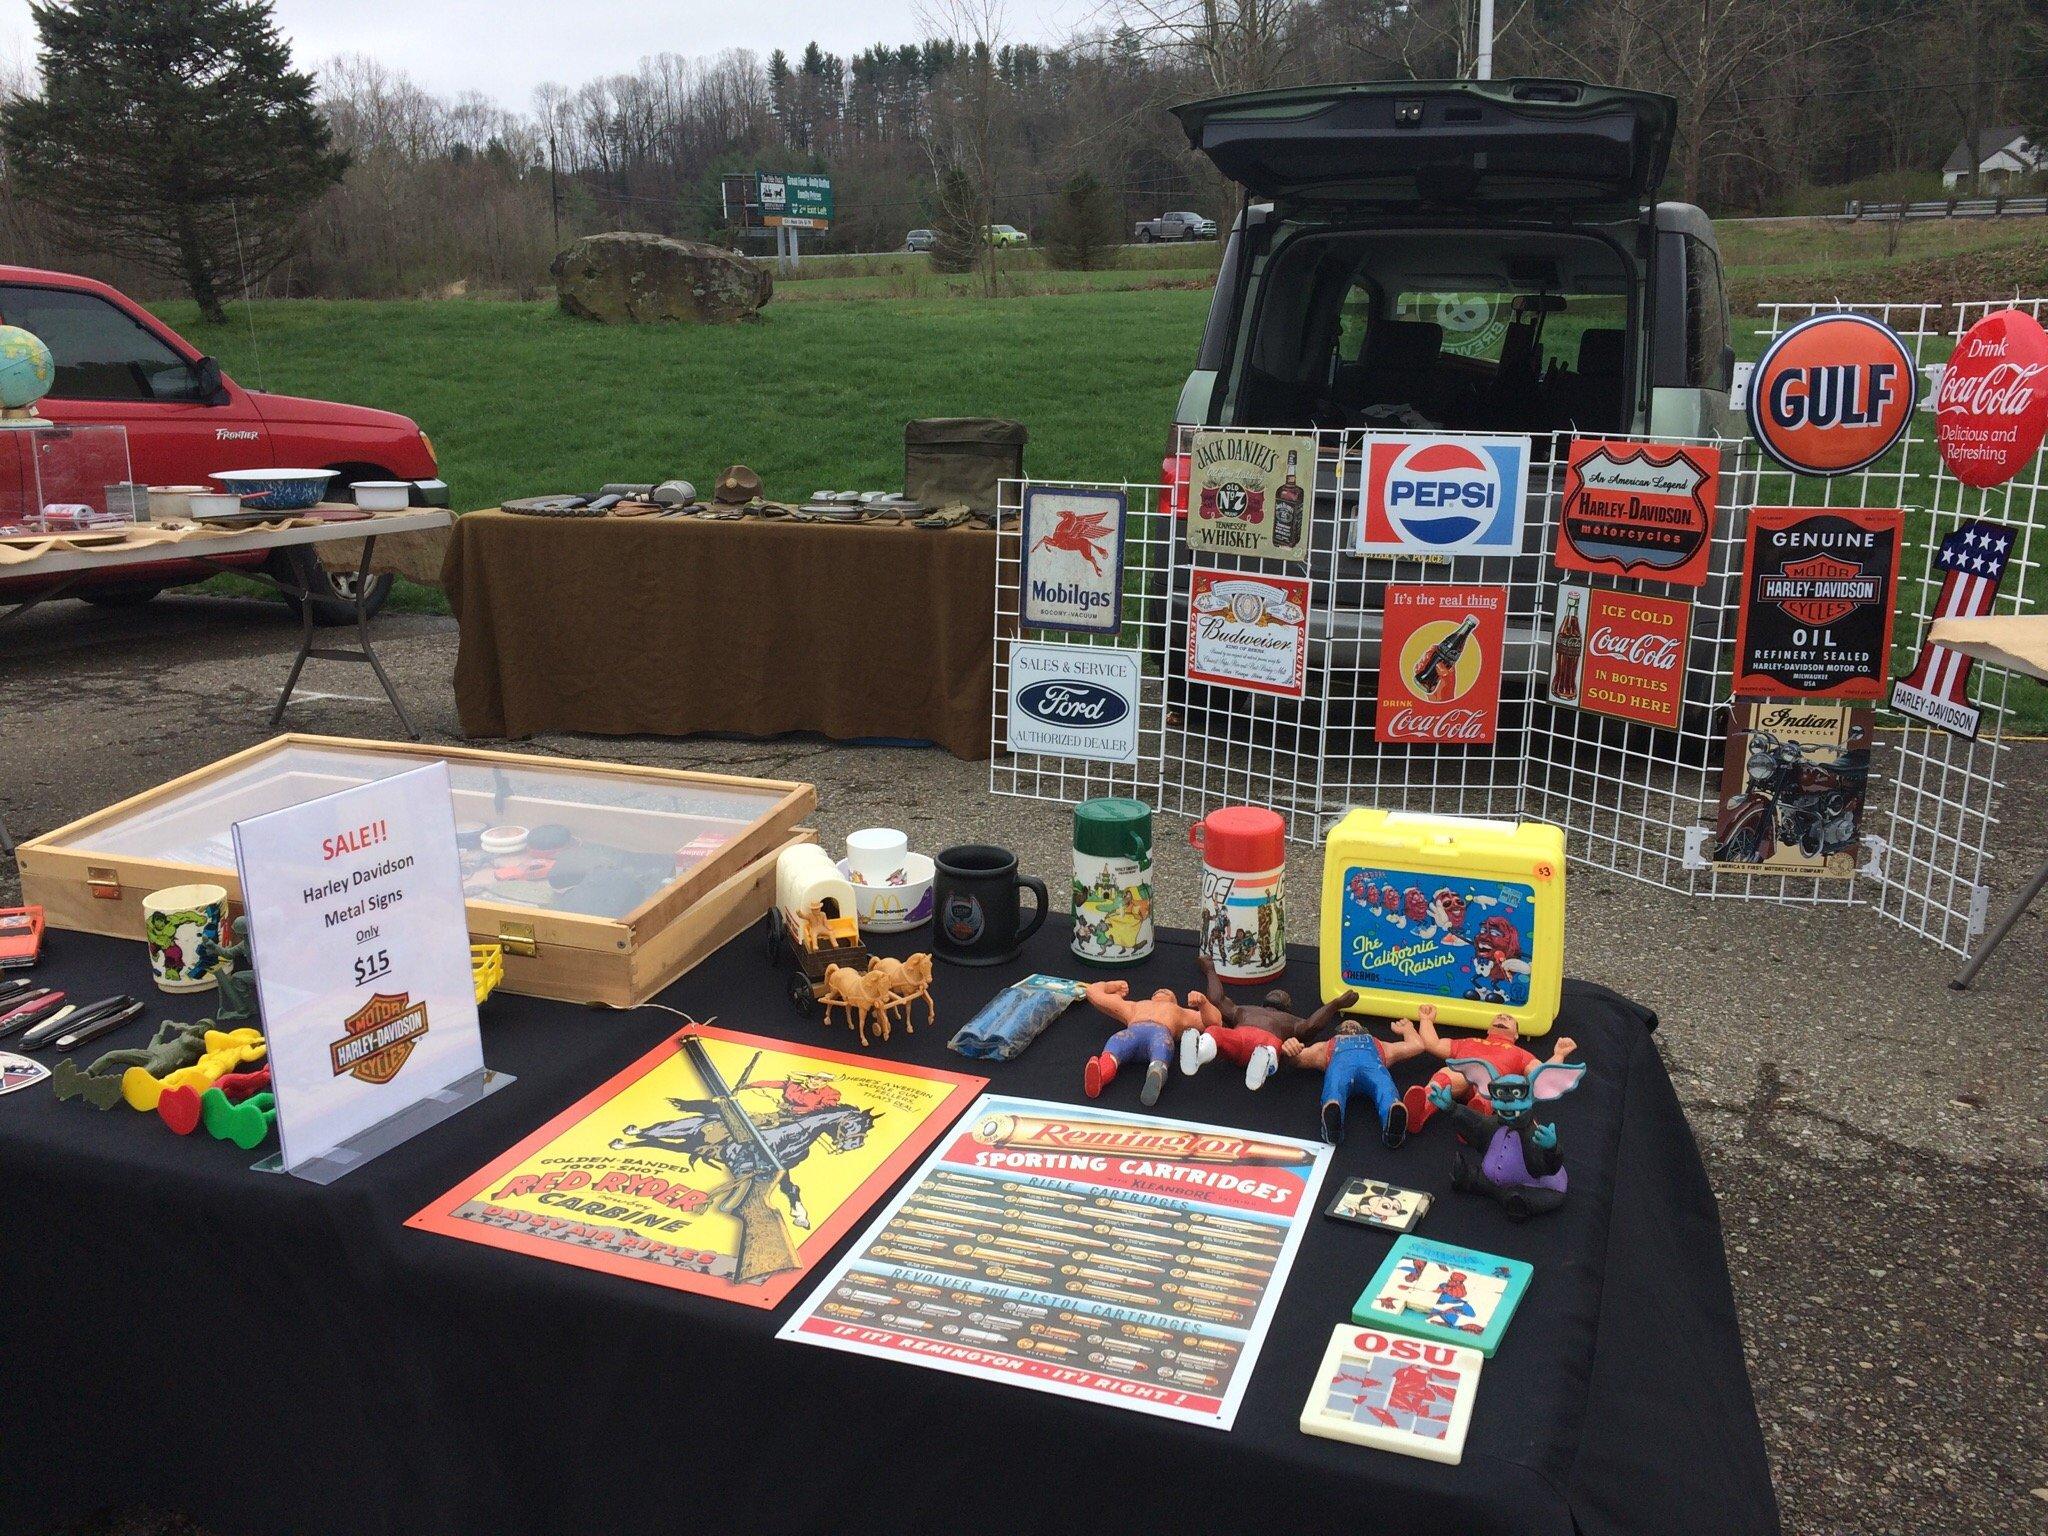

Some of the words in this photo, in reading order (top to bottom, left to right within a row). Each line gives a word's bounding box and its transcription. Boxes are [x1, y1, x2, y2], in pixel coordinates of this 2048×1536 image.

[1968, 337, 2009, 358] Drink
[1769, 363, 1898, 432] GULF
[1938, 363, 2048, 416] Coca-Cola
[1941, 424, 1989, 442] Delicious
[1991, 425, 2018, 442] and
[1197, 440, 1226, 470] JACK
[1227, 438, 1280, 473] DANIEL'S
[1947, 442, 2008, 465] Refreshing
[1390, 480, 1495, 508] PEPSI
[1589, 472, 1606, 484] An
[1608, 473, 1651, 488] American
[1651, 476, 1689, 492] Legend
[1578, 491, 1692, 526] HARLEY-DAVIDSON
[1200, 528, 1261, 550] WHISKEY
[1215, 521, 1247, 532] TENNESSEE
[1580, 523, 1681, 544] motorcycles
[1772, 532, 1875, 548] GENUINE
[1412, 553, 1444, 564] POLICE
[1793, 561, 1849, 577] MOTOR
[1032, 580, 1110, 611] Mobilgas
[1393, 592, 1412, 606] It's
[1416, 593, 1435, 606] the
[1439, 594, 1463, 606] real
[1467, 595, 1499, 610] thing
[1766, 581, 1874, 599] HARLEY-DAVIDSON
[1601, 604, 1626, 618] ICE
[1630, 609, 1674, 626] COLD
[1789, 602, 1846, 620] CYCLES
[1199, 617, 1292, 650] Budweiser
[1792, 628, 1838, 647] OIL
[1296, 627, 1305, 690] GENUINE
[1589, 626, 1682, 671] Coca-Cola
[1754, 649, 1816, 661] REFINERY
[1823, 651, 1870, 662] SEALED
[1020, 656, 1059, 672] SALES
[1062, 661, 1071, 674] &
[1073, 661, 1128, 678] SERVICE
[1752, 662, 1824, 671] HARLEY-DAVIDSON
[1826, 664, 1855, 672] MOTOR
[1857, 665, 1871, 673] CO.
[1595, 669, 1607, 681] IN
[1611, 672, 1668, 692] BOTTLES
[1037, 685, 1107, 720] Ford
[1382, 699, 1414, 708] DRINK
[1587, 687, 1627, 704] SOLD
[1630, 696, 1672, 714] HERE
[1894, 688, 1974, 731] HARLEY-DAVIDSON
[1387, 708, 1488, 739] Coca-Cola
[1761, 708, 1838, 729] Indian
[1016, 731, 1082, 747] AUTHORIZED
[1084, 736, 1127, 752] DEALER
[1763, 728, 1835, 736] MOTORCYCLE
[322, 819, 388, 862] SALE!!
[302, 876, 350, 904] Harley
[352, 853, 415, 887] Davidson
[1203, 871, 1235, 905] OE
[324, 899, 365, 928] Metal
[368, 888, 404, 918] Signs
[356, 923, 380, 944] Only
[1352, 935, 1383, 956] The
[353, 949, 392, 985] $15
[1361, 939, 1439, 970] California
[1398, 951, 1455, 977] Raisins
[1347, 970, 1380, 982] THERMOS
[355, 1002, 401, 1031] MOTOR
[337, 1010, 422, 1066] HARLEY-DAVIDSON
[361, 1044, 405, 1076] CYCLES
[893, 1084, 933, 1099] WESTERN
[1029, 1121, 1255, 1160] Remington
[540, 1156, 690, 1174] GOLDEN-BANDED
[561, 1163, 665, 1175] 1000-SHOT
[974, 1149, 1110, 1172] SPORTING
[1118, 1158, 1293, 1204] CARTRIDGES
[491, 1170, 592, 1201] RED
[591, 1171, 709, 1213] RYDER
[1028, 1175, 1076, 1192] RIFLE
[1089, 1185, 1189, 1210] CARTRIDGES
[1130, 1178, 1214, 1201] KLEANBORE
[537, 1192, 693, 1233] CARBINE
[482, 1204, 567, 1231] DAISY
[569, 1224, 616, 1243] AIR
[618, 1235, 718, 1265] RIFLES
[891, 1267, 972, 1291] REVOLVER
[981, 1284, 1009, 1298] and
[1018, 1290, 1079, 1314] PISTOL
[1091, 1303, 1203, 1333] CARTRIDGES
[1354, 1331, 1458, 1367] OSU
[832, 1325, 854, 1336] IF
[859, 1330, 893, 1344] IT'S
[898, 1338, 1024, 1371] REMINGTON
[1051, 1369, 1091, 1384] IT'S
[1094, 1377, 1170, 1401] RIGHT
